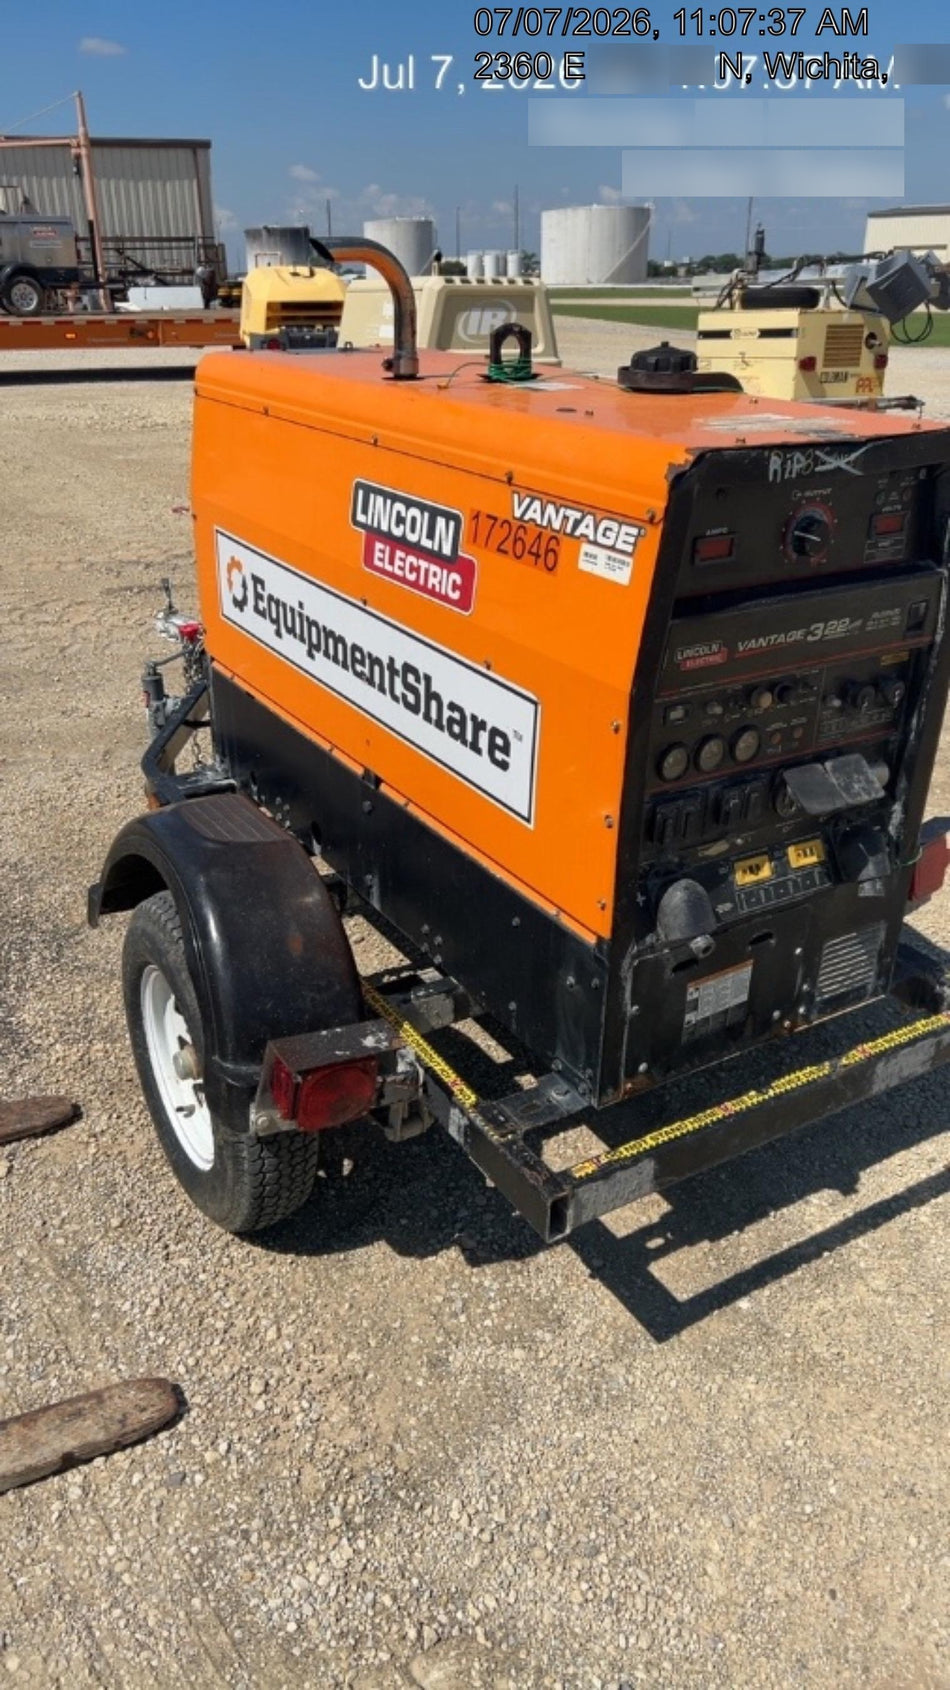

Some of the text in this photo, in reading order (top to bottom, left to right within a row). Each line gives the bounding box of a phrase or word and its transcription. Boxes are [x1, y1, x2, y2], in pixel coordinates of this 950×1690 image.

[355, 488, 456, 557] LINCOLN
[470, 510, 560, 573] 172646
[511, 492, 641, 554] VANTAGE
[373, 540, 463, 601] ELECTRIC
[681, 643, 720, 661] LINCOLN
[737, 629, 806, 652] VANTAGE
[251, 573, 512, 772] EquipmentShare
